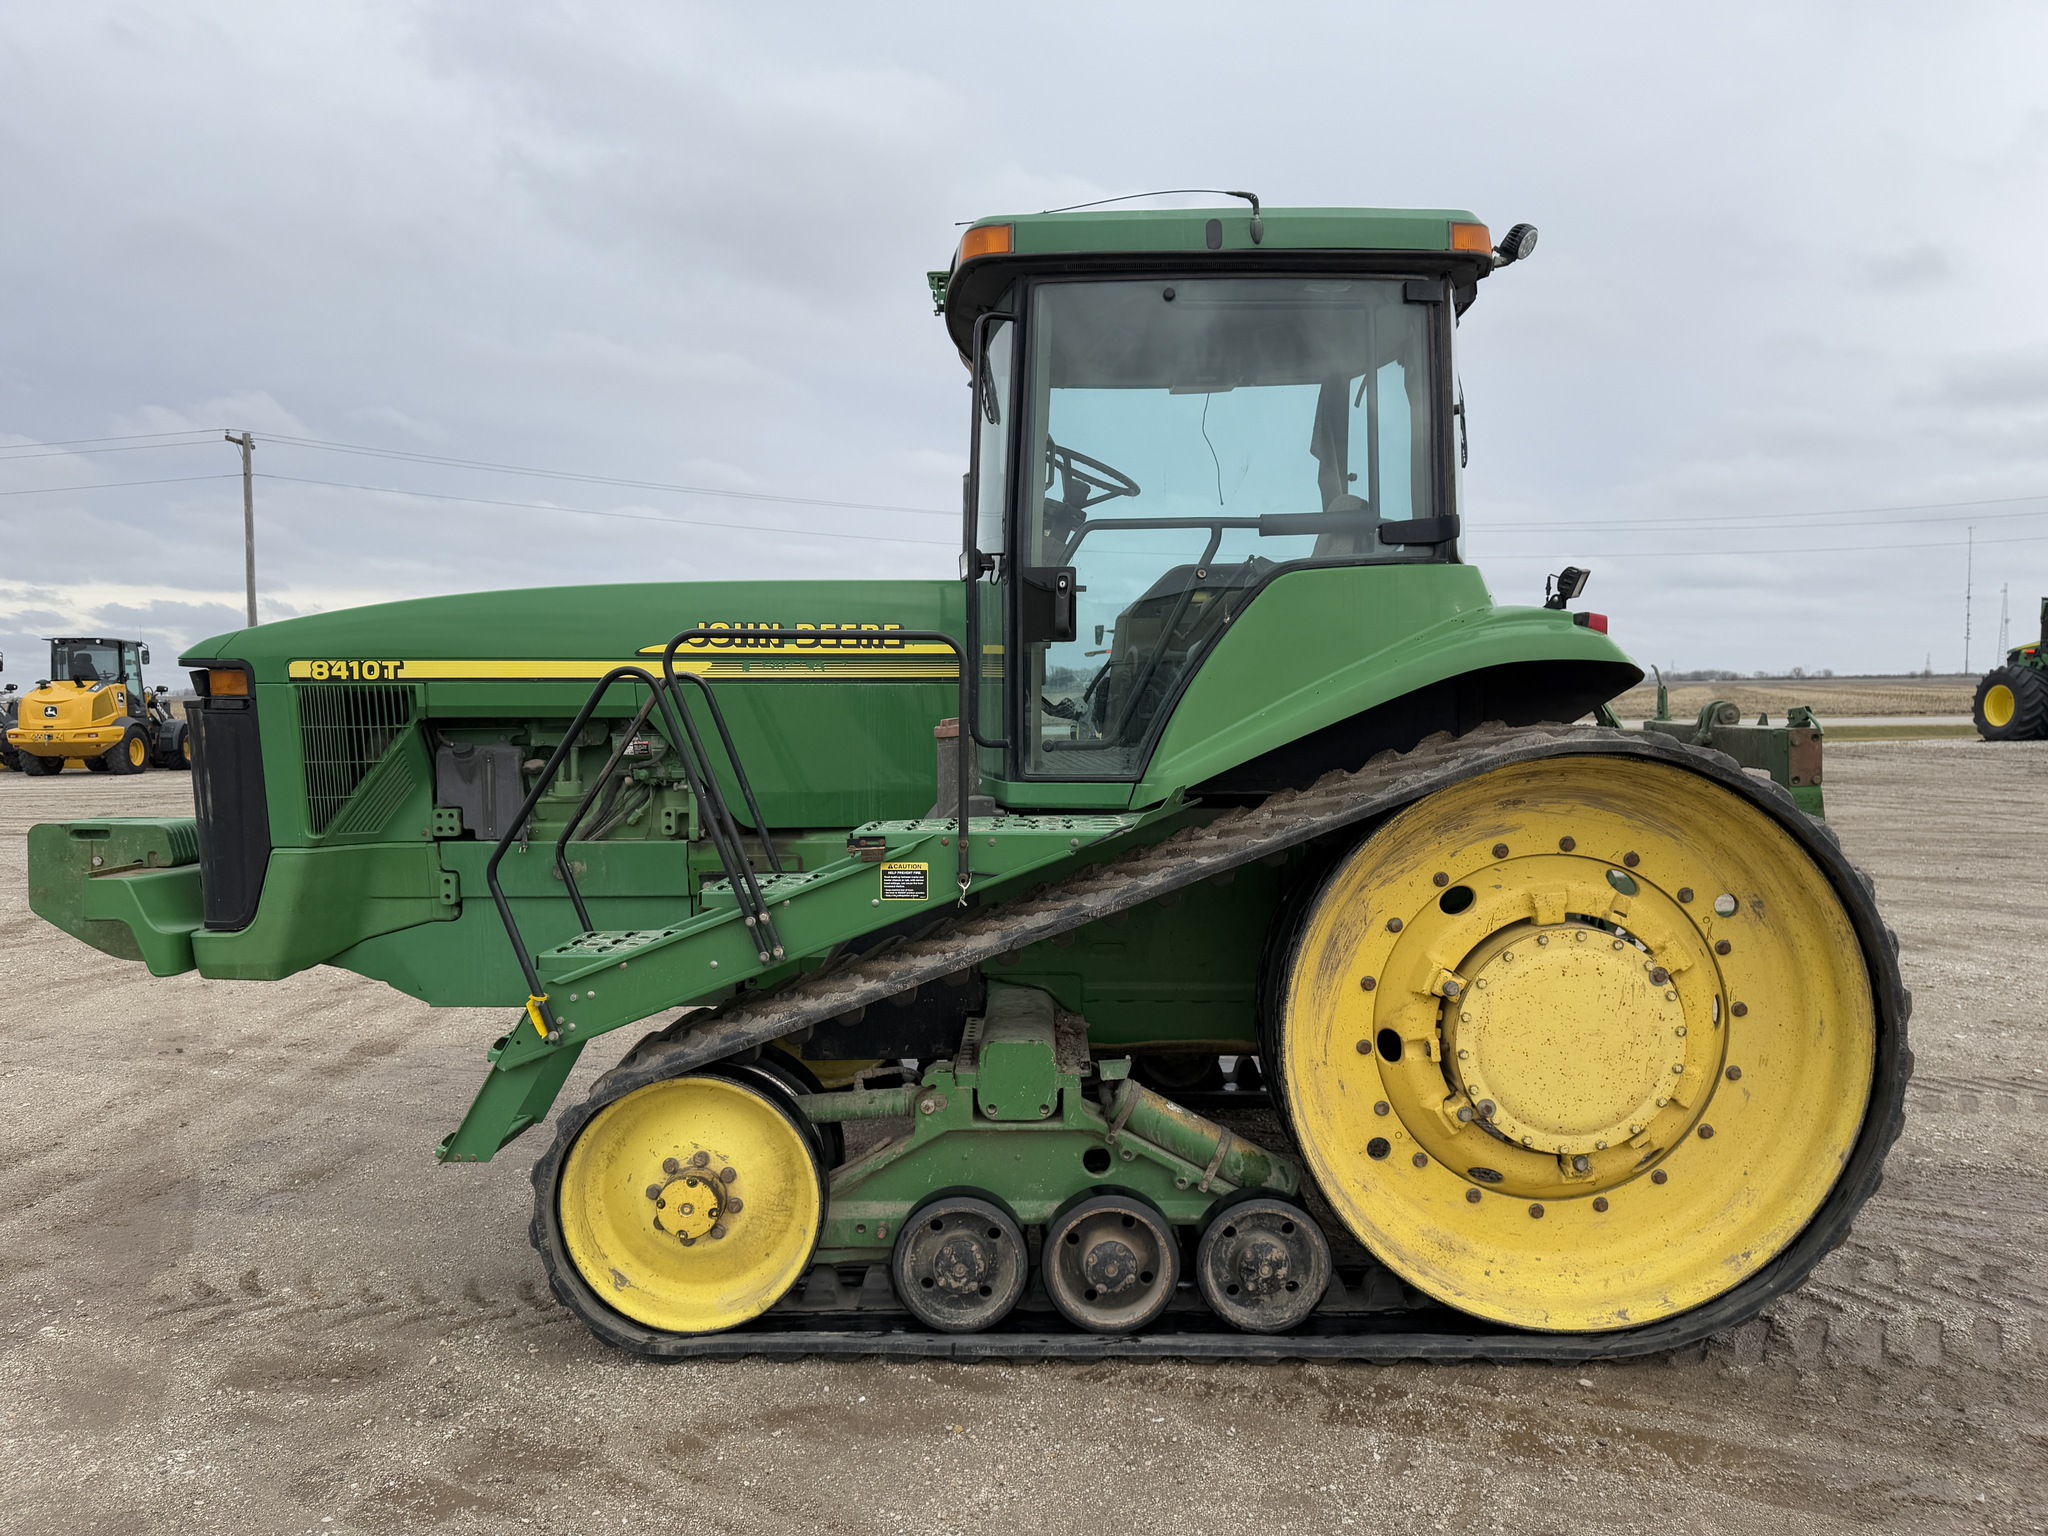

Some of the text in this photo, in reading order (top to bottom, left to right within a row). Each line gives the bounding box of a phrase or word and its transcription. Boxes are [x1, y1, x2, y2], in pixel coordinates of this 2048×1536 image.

[687, 621, 905, 649] JOHN DEERE
[311, 660, 403, 680] 8410T
